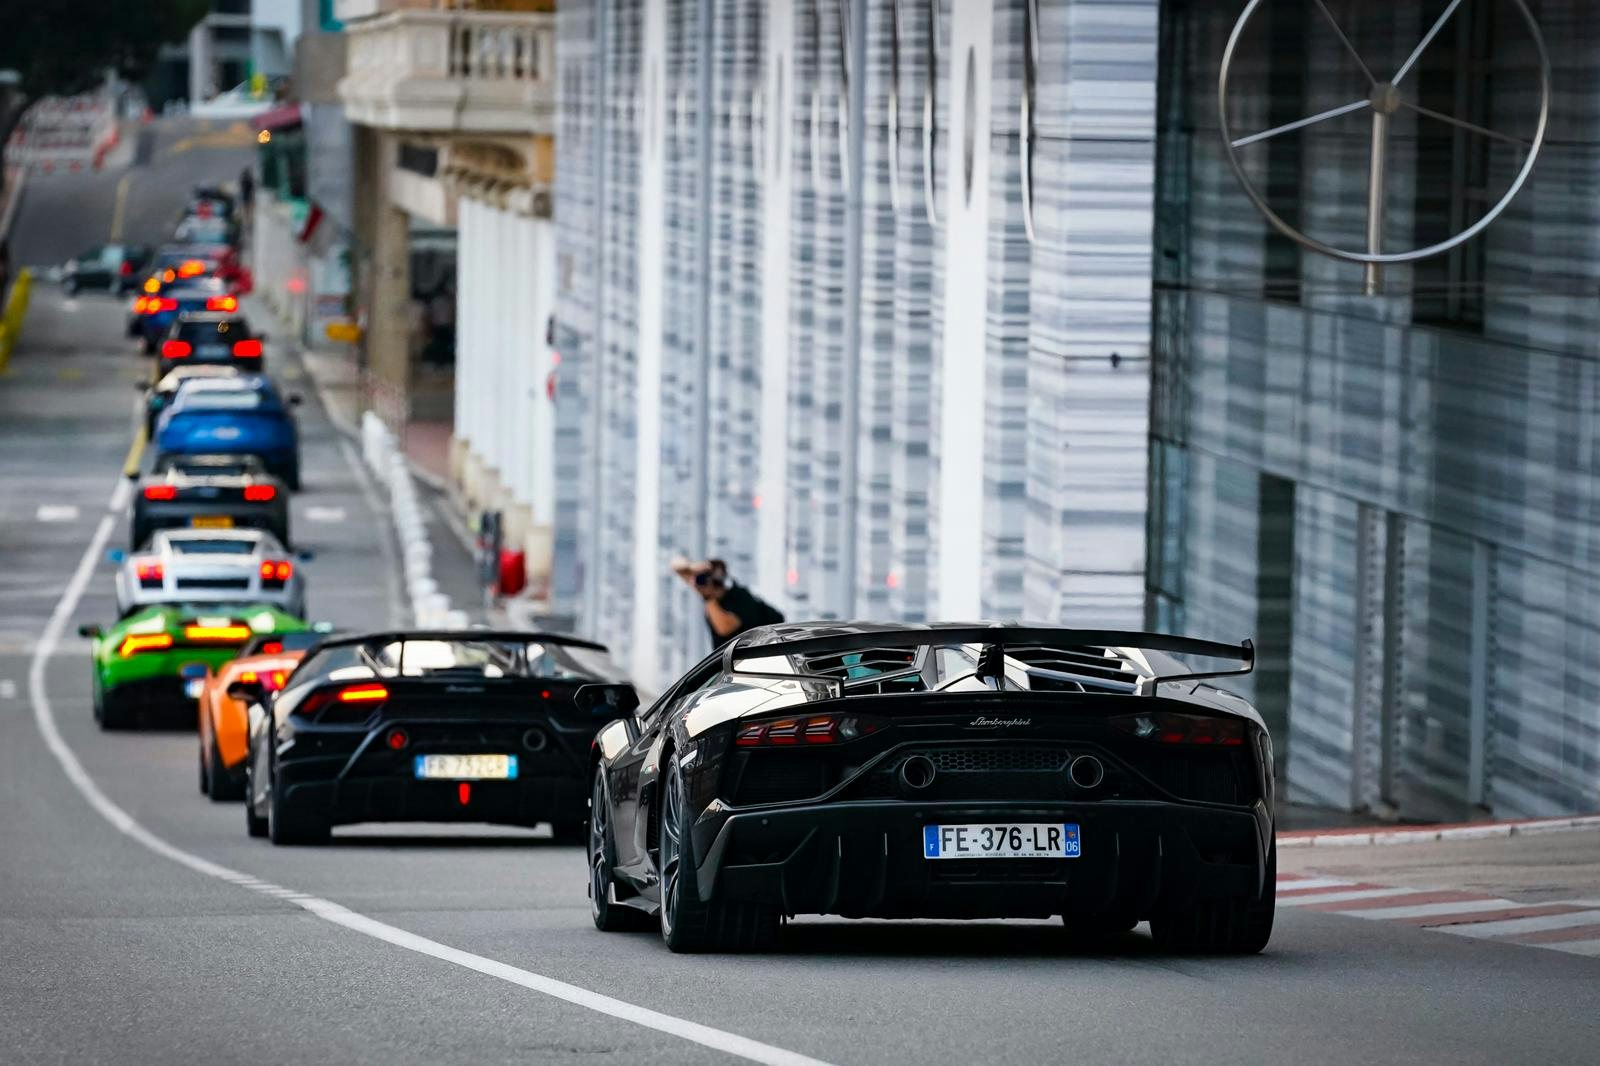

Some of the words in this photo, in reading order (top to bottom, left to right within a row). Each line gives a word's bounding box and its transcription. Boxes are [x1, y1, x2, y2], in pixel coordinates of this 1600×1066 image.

[970, 716, 1031, 727] Lamborghini
[941, 826, 1061, 852] FE-376-LR
[1066, 841, 1078, 852] 06
